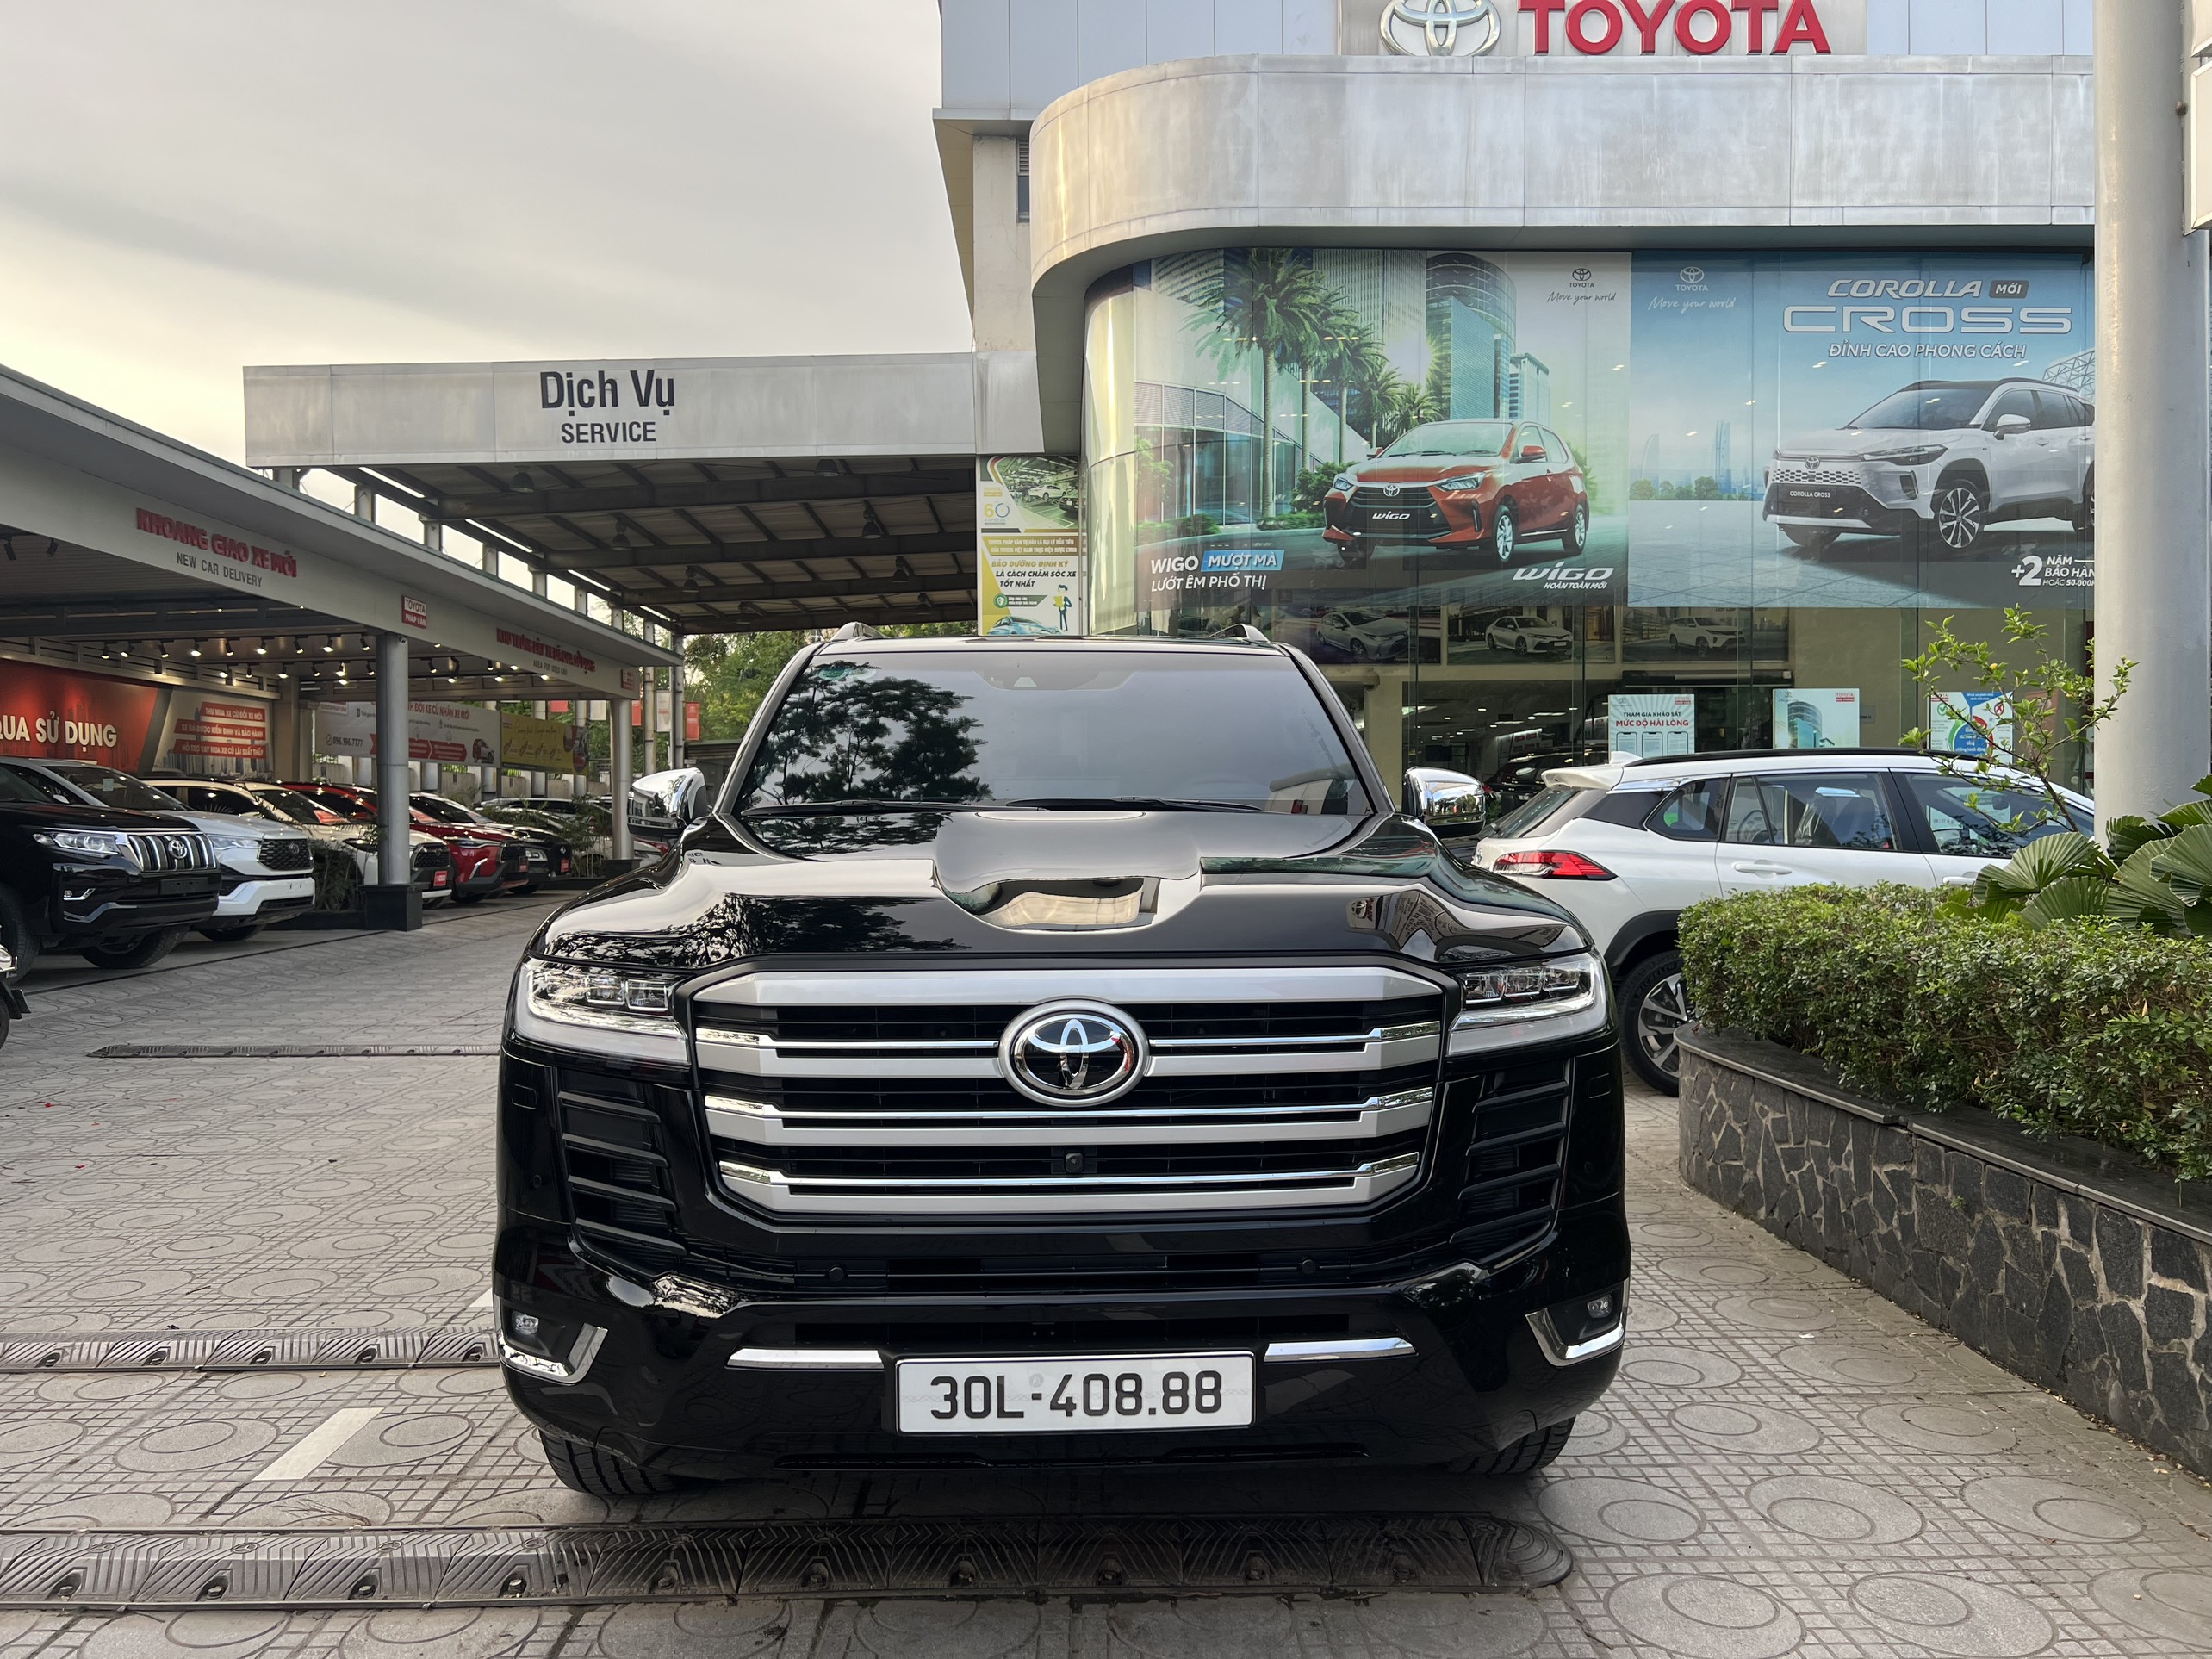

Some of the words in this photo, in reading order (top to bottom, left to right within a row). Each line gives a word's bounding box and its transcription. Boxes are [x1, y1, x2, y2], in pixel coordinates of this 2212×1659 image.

[1518, 0, 1831, 55] TOYOTA
[1547, 291, 1572, 302] Move
[1575, 295, 1592, 305] your
[1595, 292, 1617, 301] world
[1827, 280, 1983, 299] COROLLA
[1994, 283, 2022, 295] MỚI
[1648, 296, 1679, 310] Move
[1681, 301, 1706, 314] your
[1708, 297, 1737, 308] world
[1783, 306, 2072, 333] CROSS
[1828, 340, 1870, 357] ĐỈNH
[1874, 344, 1911, 357] CAO
[1914, 345, 1978, 358] PHONG
[1979, 341, 2026, 358] CÁCH
[540, 370, 618, 416] Dịch
[630, 370, 674, 415] Vụ
[561, 421, 656, 444] SERVICE
[1151, 556, 1199, 574] WIGO
[1208, 554, 1252, 569] MƯỢT
[1253, 551, 1277, 566] MÀ
[2047, 554, 2072, 565] NĂM
[177, 552, 196, 569] NEW
[202, 560, 219, 575] CAR
[223, 566, 263, 587] DELIVERY
[2011, 556, 2043, 586] +2
[2044, 564, 2070, 577] BẢO
[1000, 578, 1014, 587] TỐT
[1015, 579, 1035, 587] NHẤT
[1151, 575, 1184, 592] LƯỚT
[1185, 575, 1205, 588] ÊM
[1209, 571, 1240, 587] PHỐ
[1244, 575, 1267, 591] THỊ
[1543, 581, 1568, 589] HOÀN
[1568, 581, 1590, 589] TOÀN
[1590, 581, 1608, 589] MỚI
[2042, 579, 2065, 587] HOẶC
[405, 599, 426, 612] TOYOTA
[533, 659, 542, 668] AREA
[0, 715, 30, 741] UA
[35, 711, 59, 743] SỬ
[65, 720, 117, 752] DỤNG
[1636, 718, 1648, 728] ĐỘ
[930, 1370, 1222, 1420] 30L-408.88
